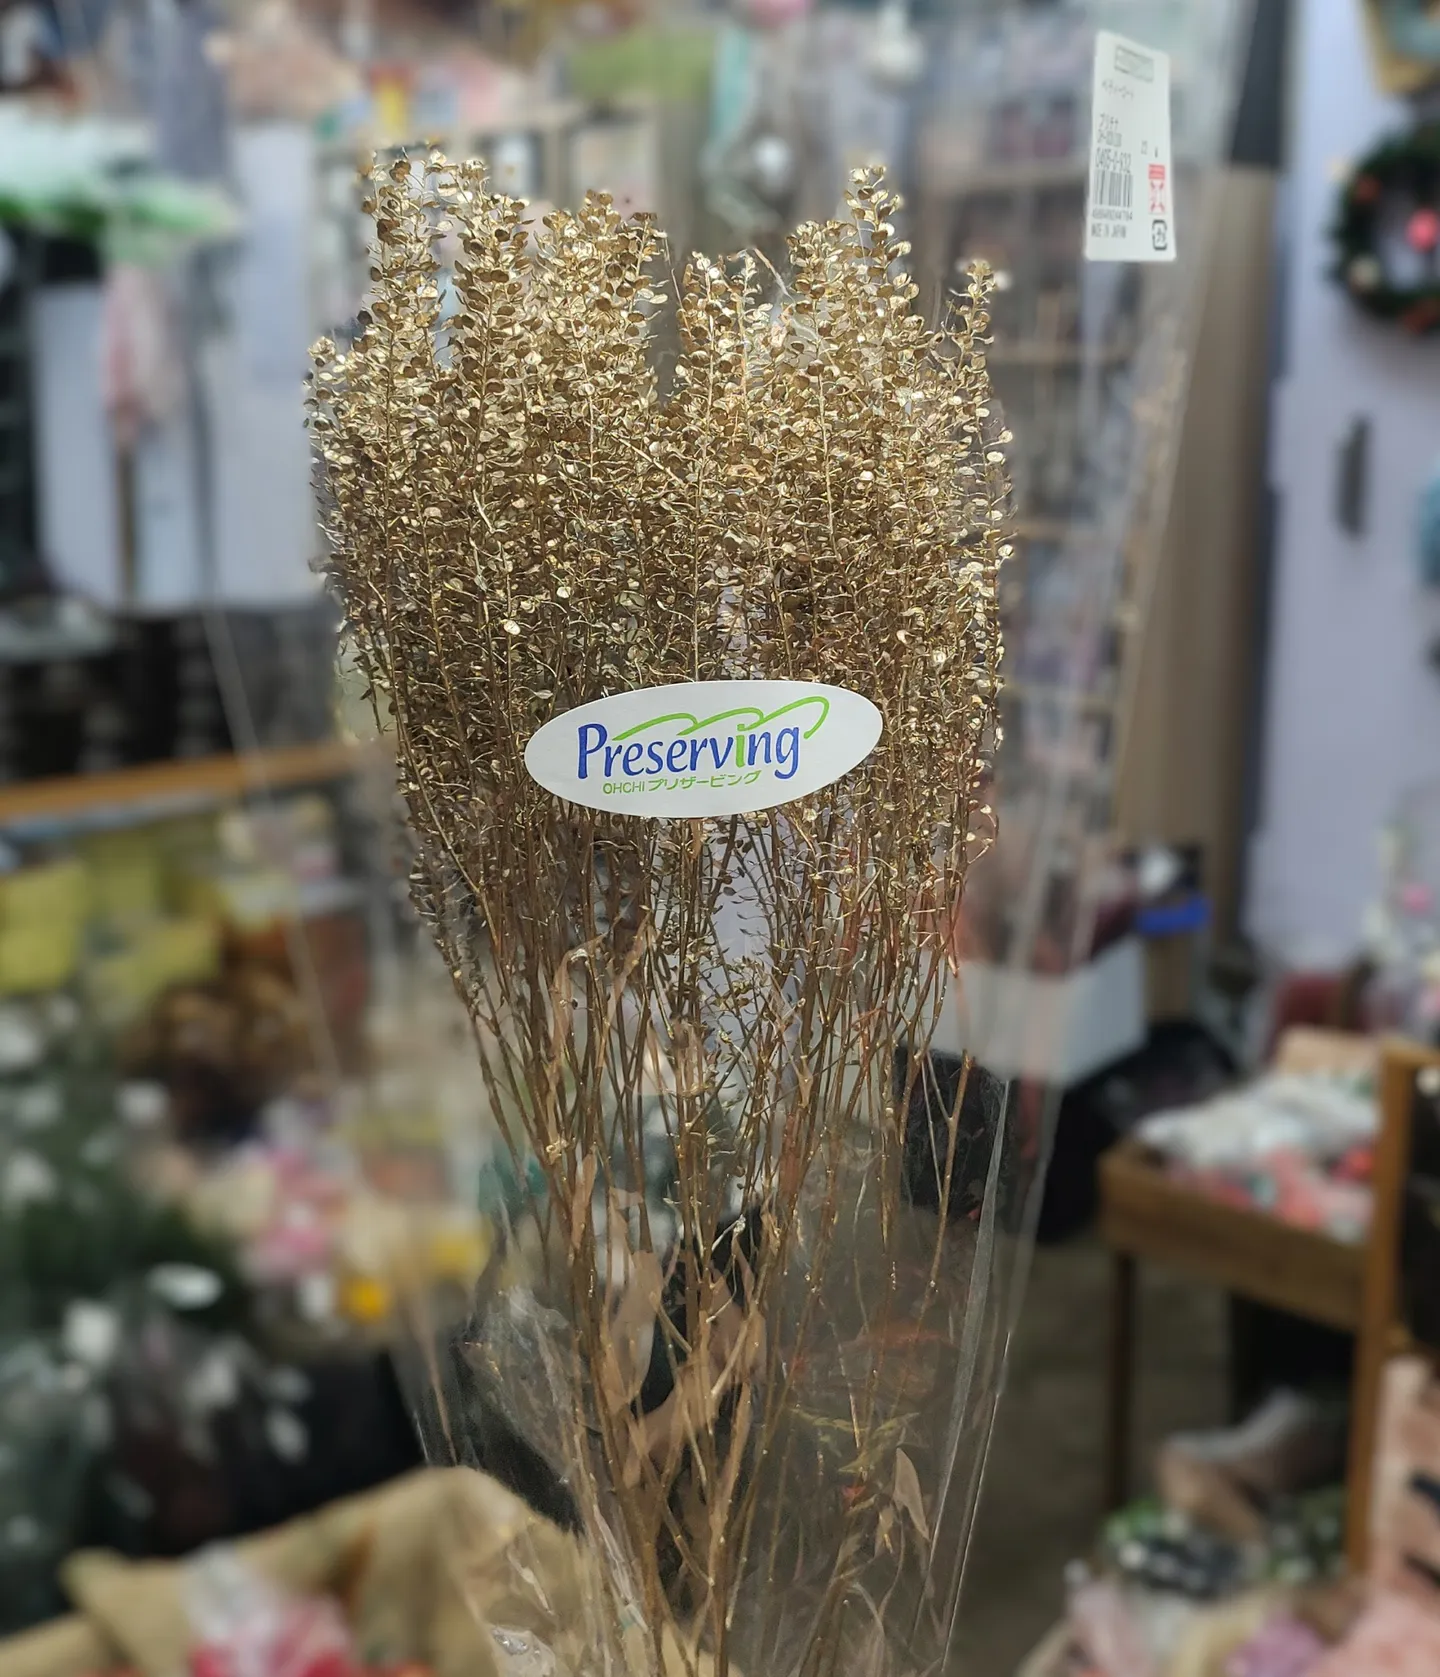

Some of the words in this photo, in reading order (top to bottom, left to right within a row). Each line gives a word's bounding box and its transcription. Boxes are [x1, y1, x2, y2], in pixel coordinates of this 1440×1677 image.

[577, 723, 800, 779] Preserving
[602, 780, 645, 795] OHCHI
[648, 770, 762, 792] プリザービング
